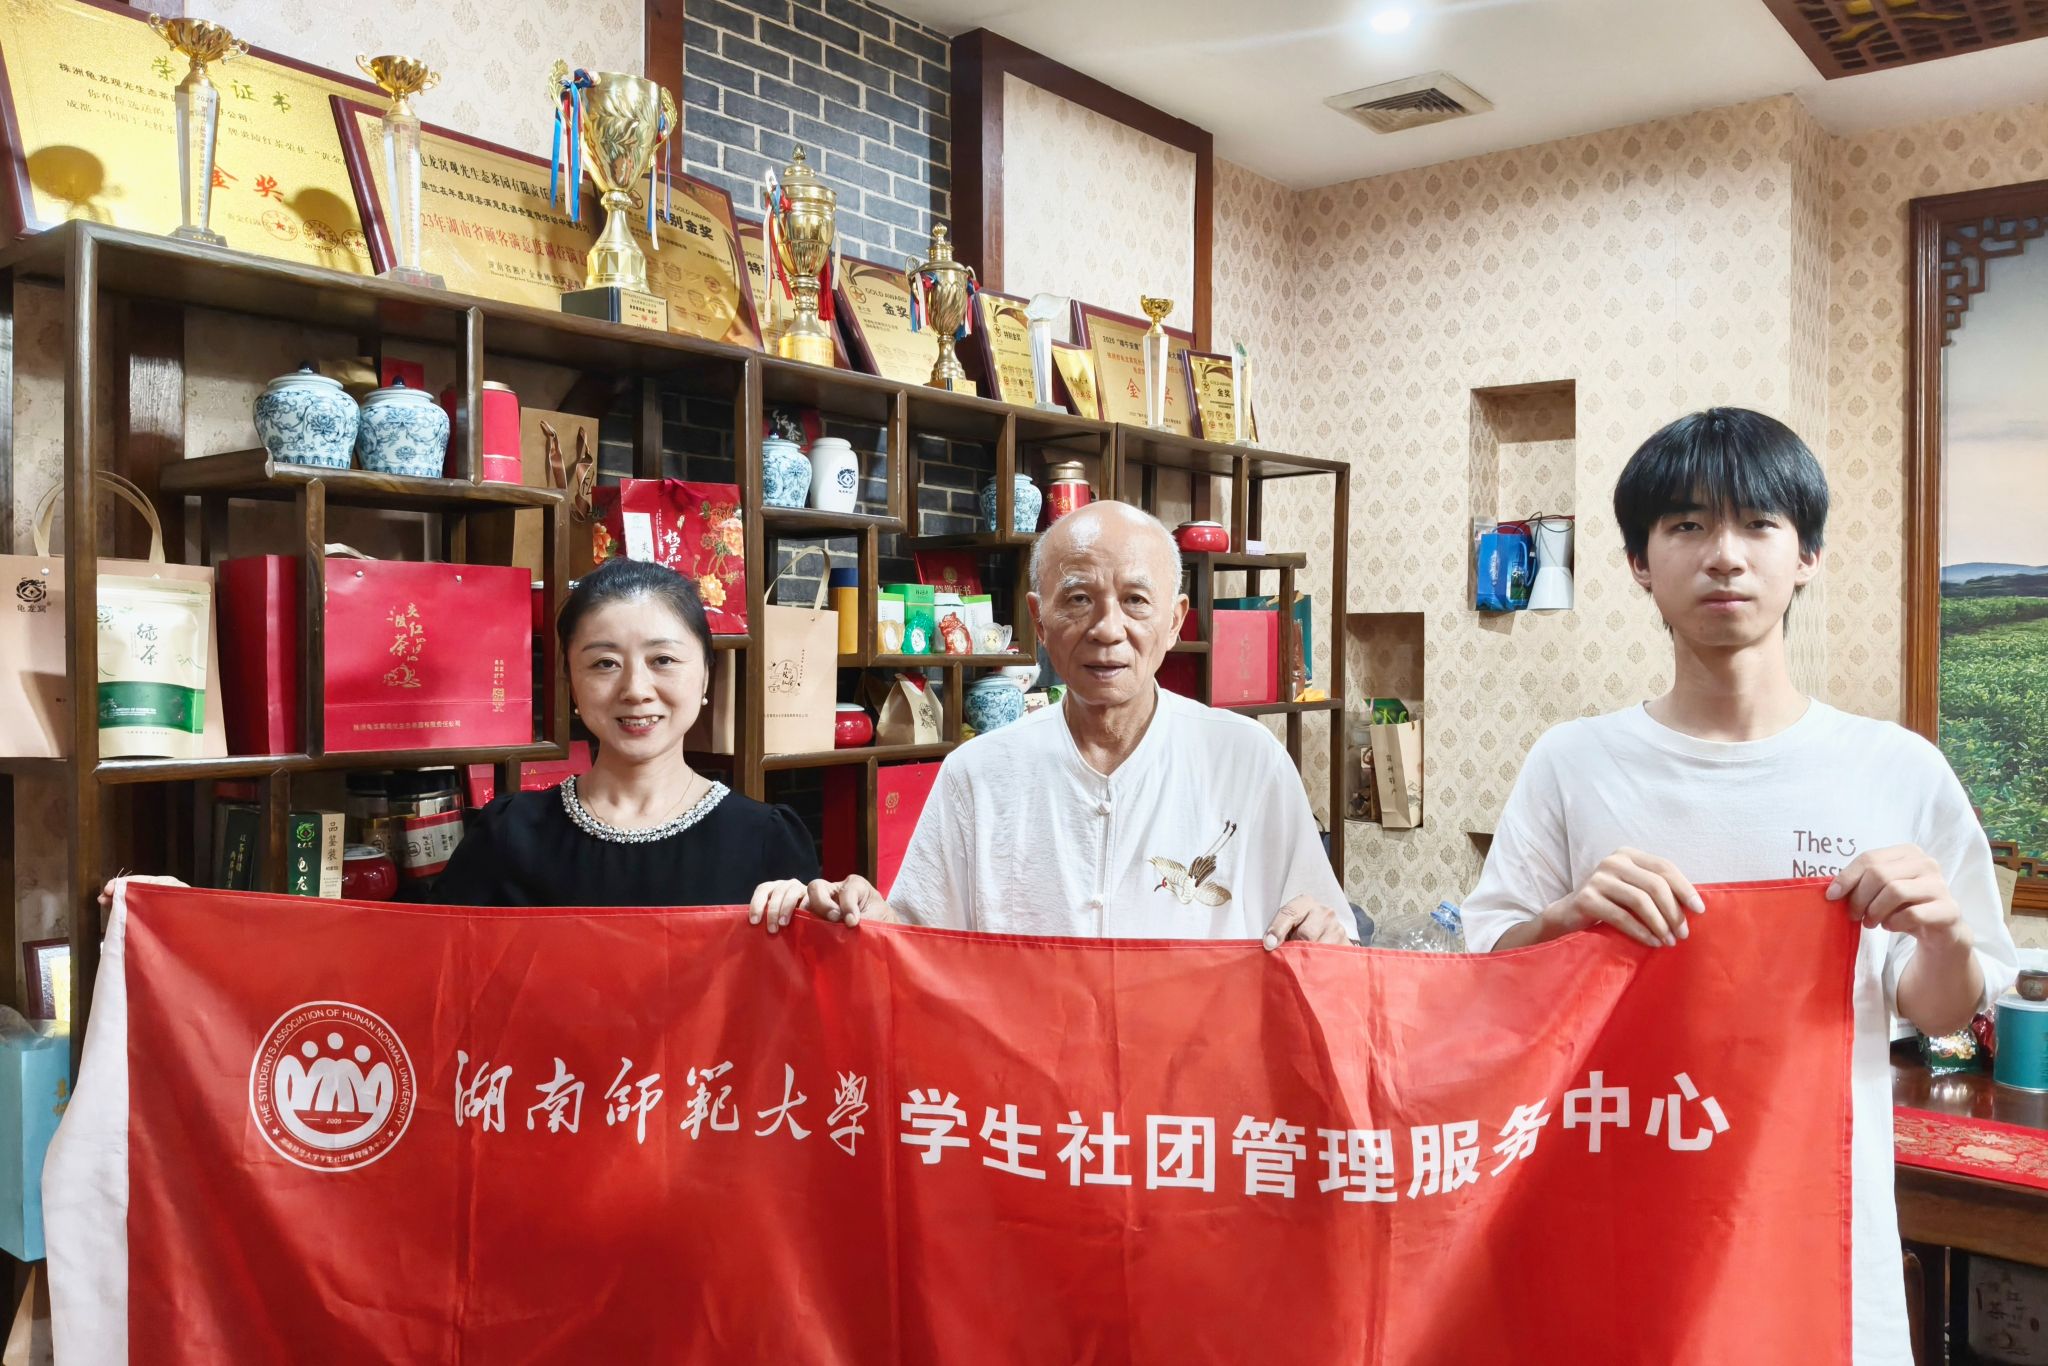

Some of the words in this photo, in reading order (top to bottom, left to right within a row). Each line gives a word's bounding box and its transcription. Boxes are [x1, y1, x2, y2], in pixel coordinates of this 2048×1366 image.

[882, 302, 911, 320] 金奖
[136, 623, 158, 666] 绿茶
[1793, 830, 1832, 854] The
[273, 1009, 325, 1048] ASSOCIATION
[325, 1008, 340, 1018] OF
[342, 1010, 377, 1032] HUNAN
[375, 1026, 402, 1067] NORMAL
[258, 1046, 277, 1102] STUDENTS
[259, 1105, 273, 1125] THE
[395, 1067, 411, 1127] UNIVERSITY
[901, 1071, 1730, 1203] 学生社团管理服务中心
